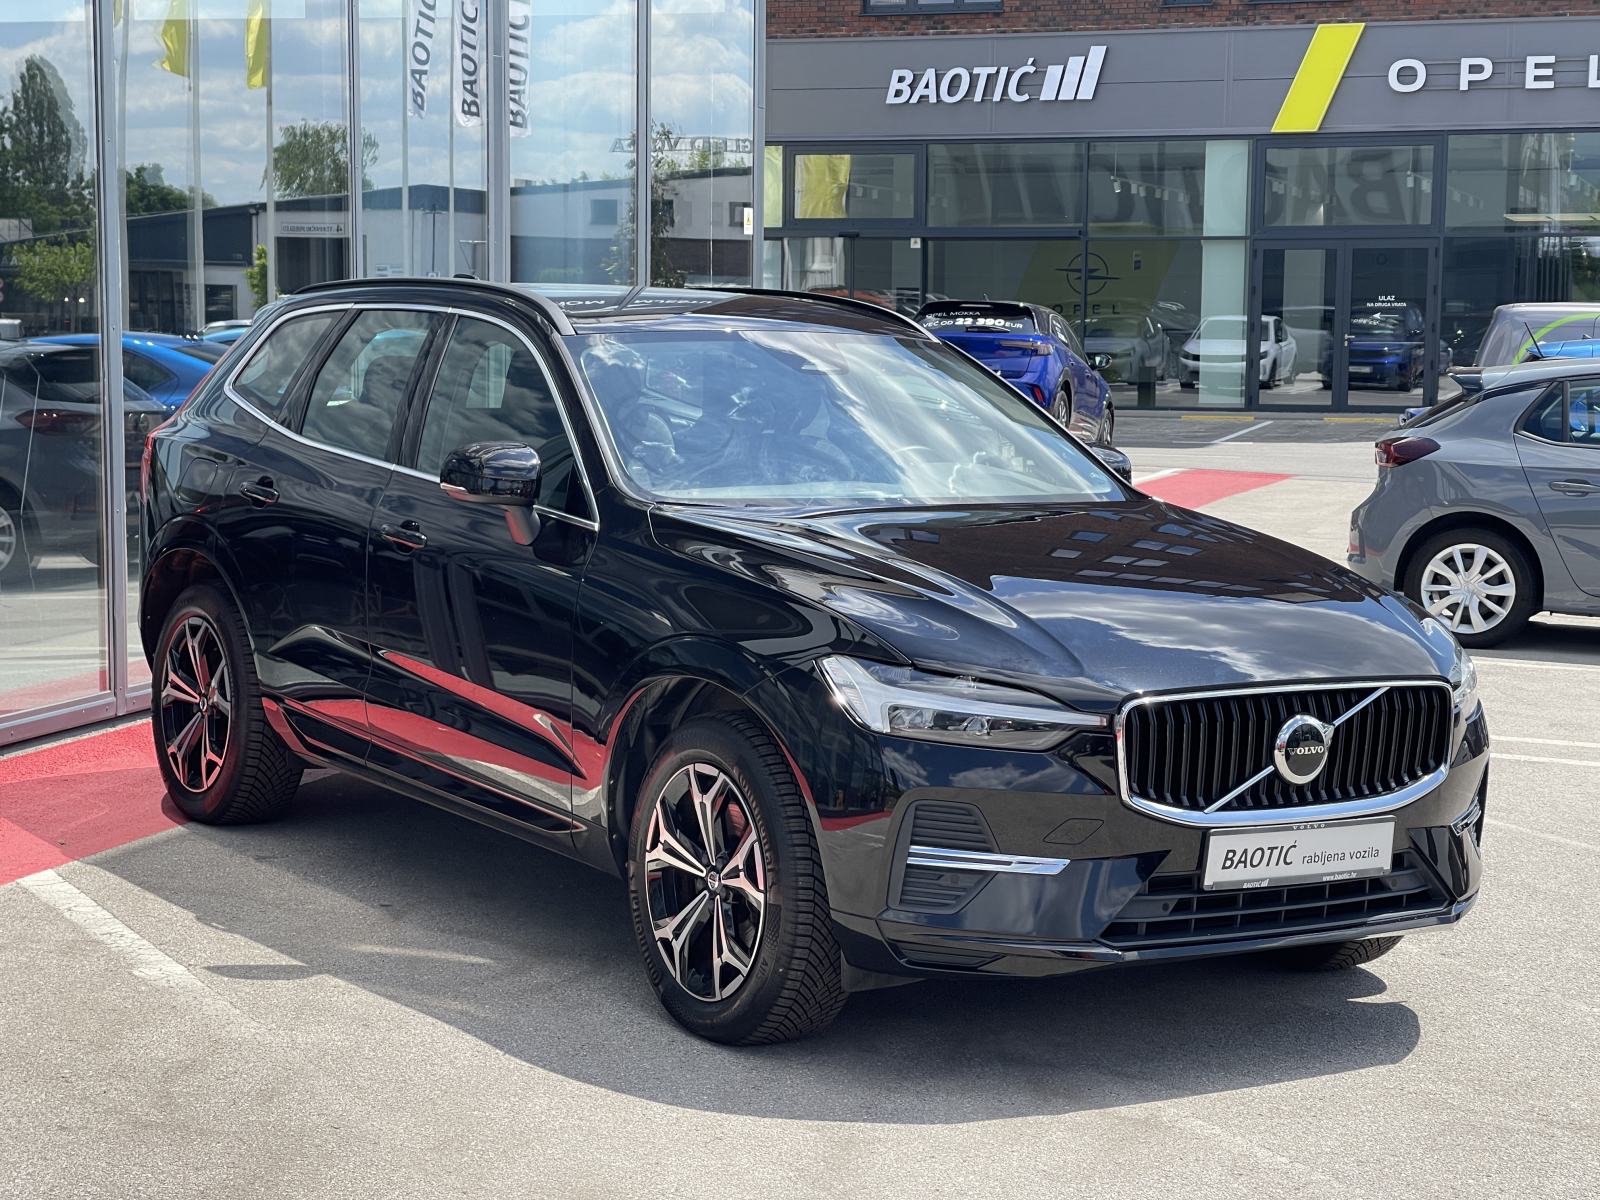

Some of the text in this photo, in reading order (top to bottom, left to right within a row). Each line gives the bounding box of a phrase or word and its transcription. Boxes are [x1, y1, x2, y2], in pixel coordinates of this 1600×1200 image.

[885, 57, 1037, 104] BAOTIĆ
[1388, 54, 1600, 93] OPEL
[1053, 303, 1121, 315] OPEL
[954, 317, 973, 325] 22
[975, 317, 1005, 327] 390
[1004, 321, 1024, 329] EUR
[1287, 745, 1325, 756] VOLVO
[1221, 840, 1380, 871] BAOTIĆ rabljena vozila
